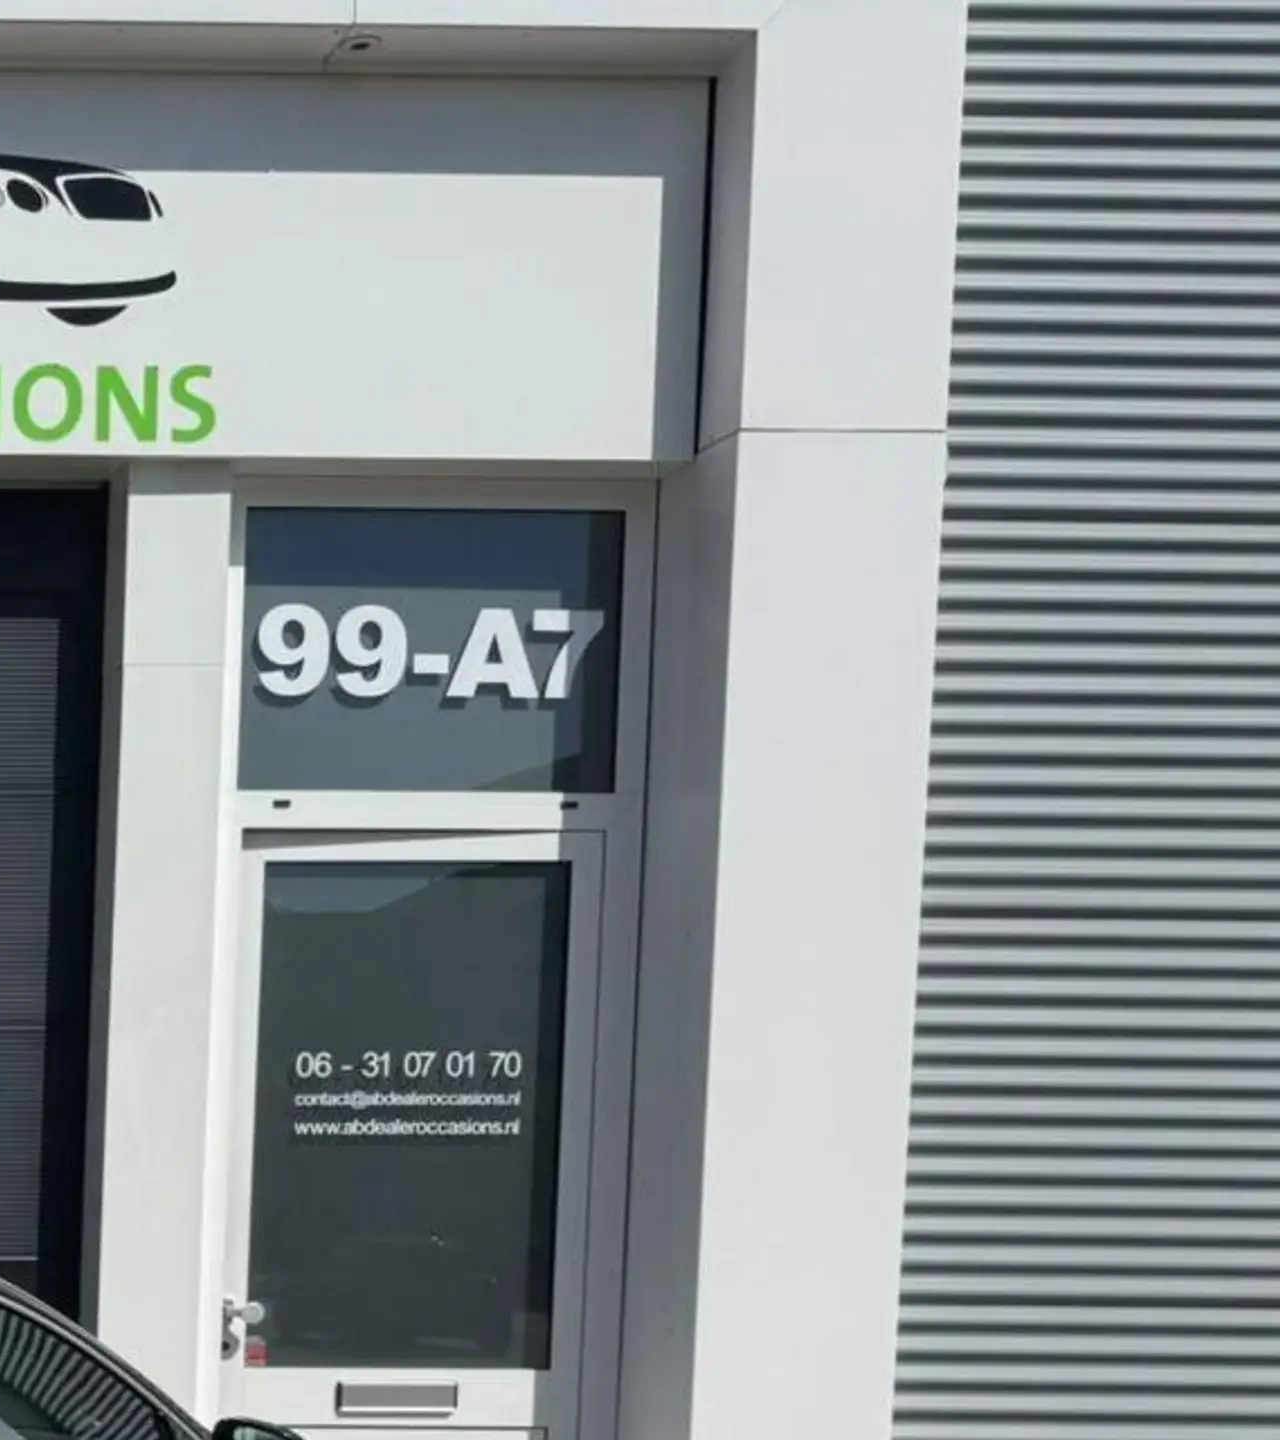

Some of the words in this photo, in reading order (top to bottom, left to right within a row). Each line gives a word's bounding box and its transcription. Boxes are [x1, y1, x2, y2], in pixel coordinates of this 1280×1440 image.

[257, 602, 605, 700] 99-A7
[295, 1051, 333, 1078] 06
[361, 1051, 390, 1078] 31
[403, 1051, 437, 1078] 07
[445, 1051, 475, 1078] 01
[488, 1051, 522, 1078] 70
[294, 1089, 521, 1110] contact@abdealeroccasions.nl
[294, 1117, 521, 1135] www.abdealeroccasions.nl
